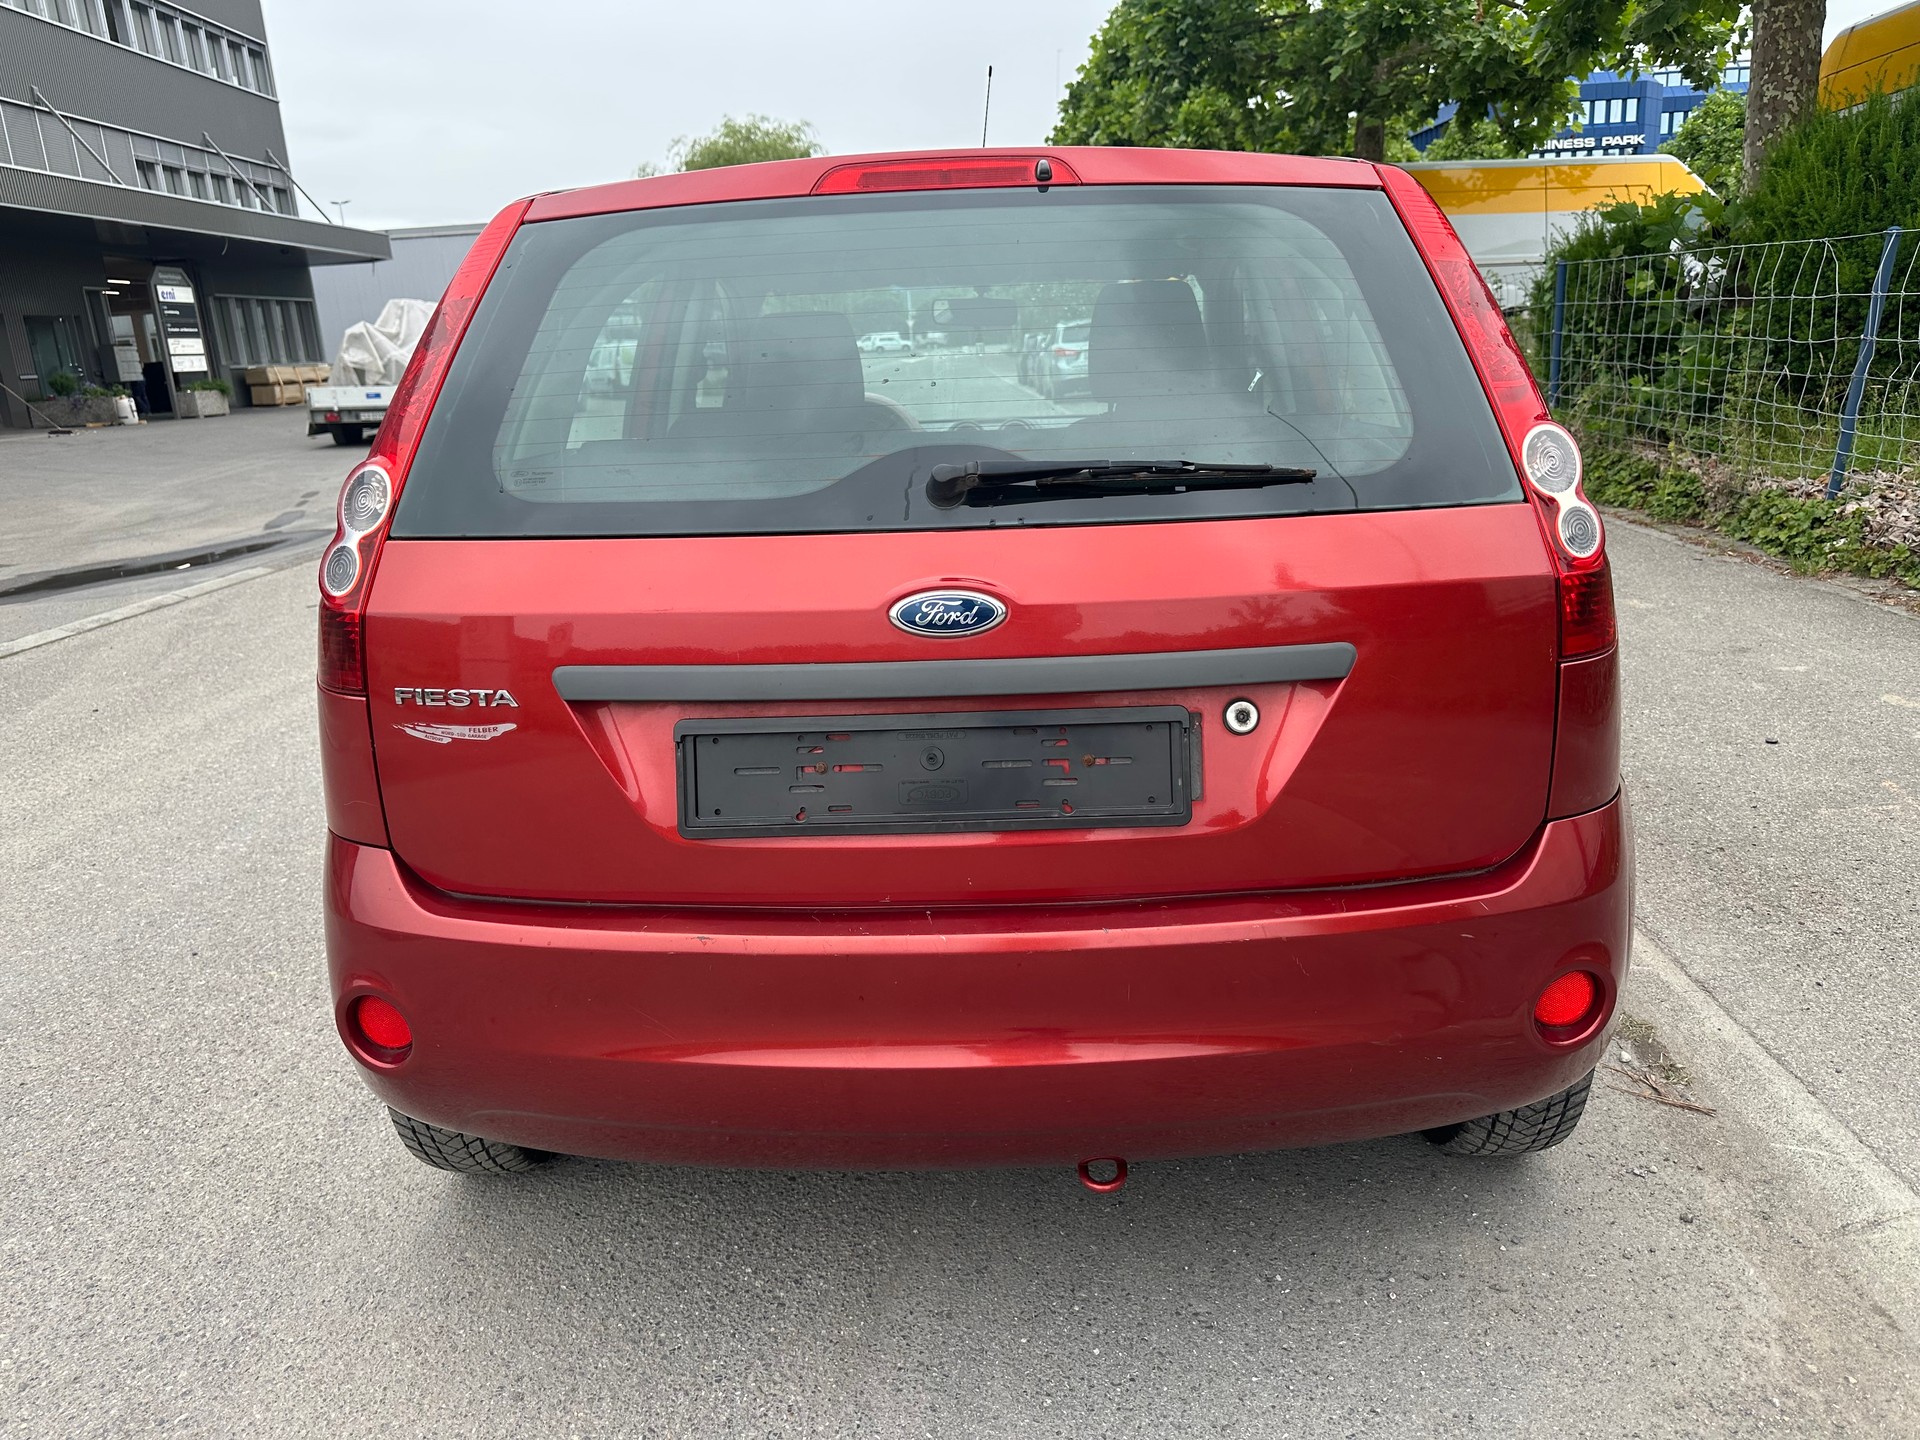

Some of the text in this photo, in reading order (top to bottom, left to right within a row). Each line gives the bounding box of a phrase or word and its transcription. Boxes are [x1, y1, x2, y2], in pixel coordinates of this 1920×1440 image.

[1601, 134, 1646, 147] PARK
[160, 288, 176, 300] erni
[915, 599, 980, 626] Ford
[394, 687, 520, 708] FIESTA
[468, 726, 499, 734] FELBER
